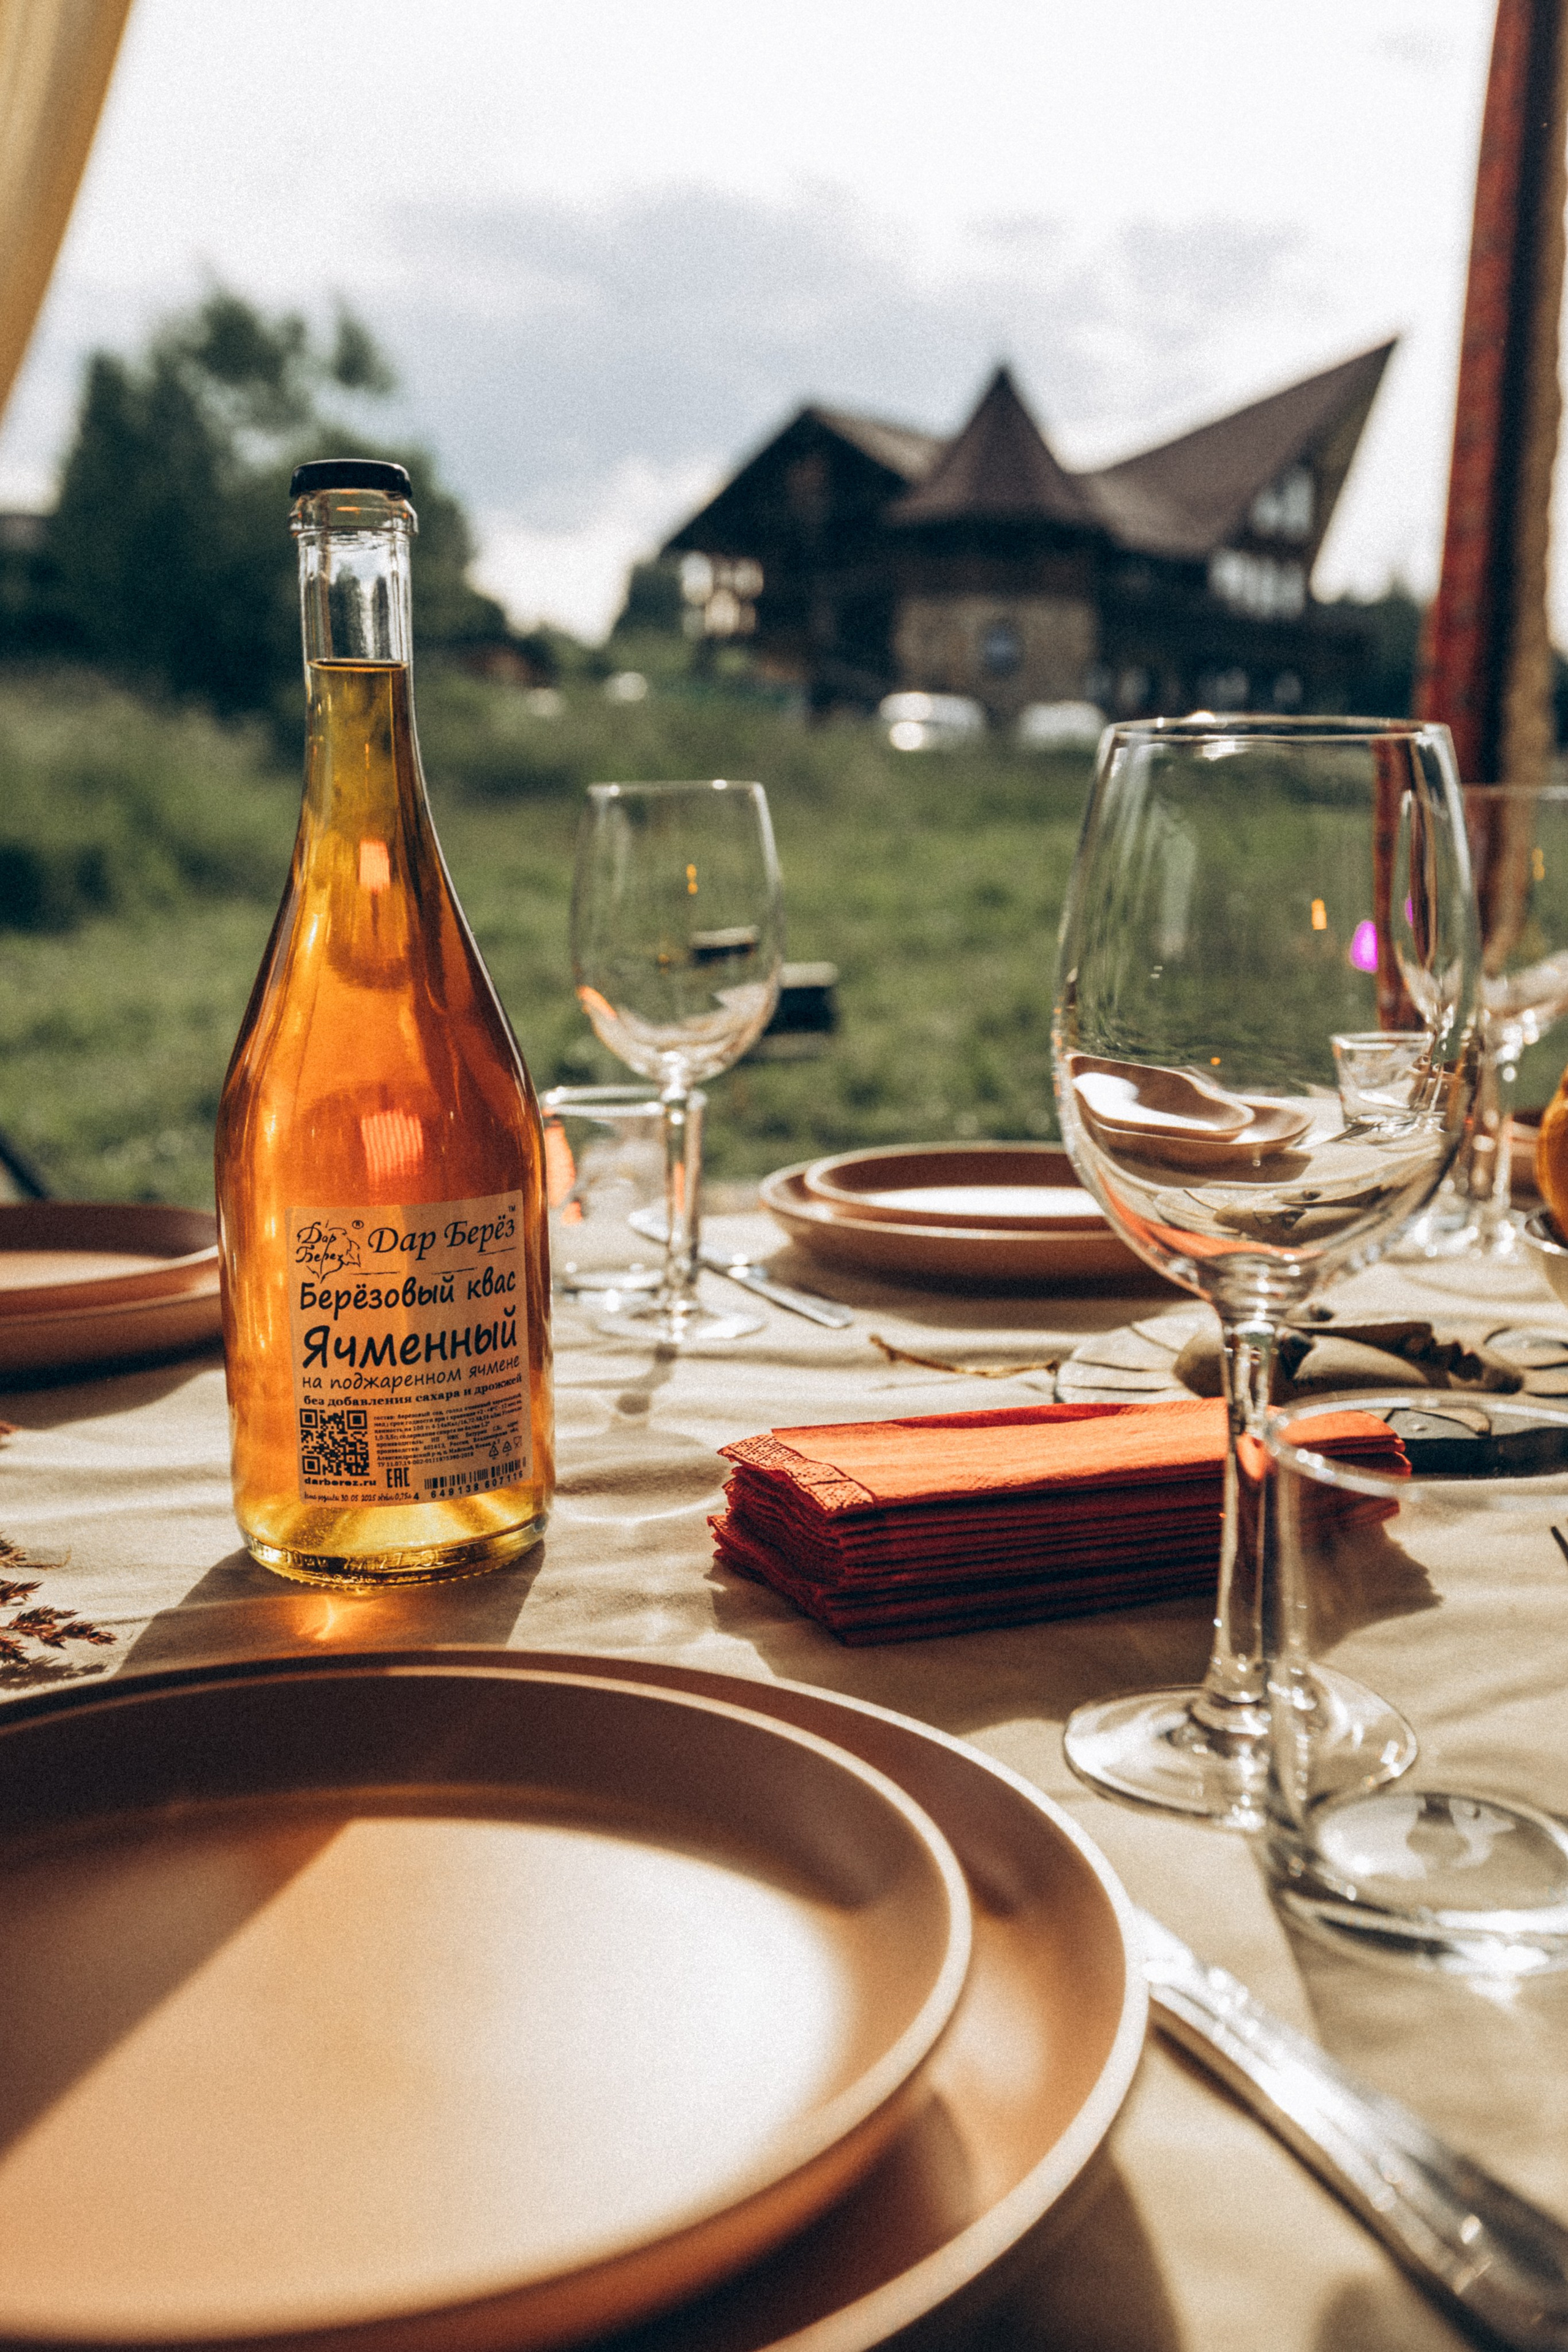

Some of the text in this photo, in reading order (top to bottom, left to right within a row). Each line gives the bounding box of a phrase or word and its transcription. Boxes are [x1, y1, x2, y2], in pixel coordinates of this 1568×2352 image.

[297, 1221, 337, 1244] Дар
[368, 1227, 437, 1261] Дар
[444, 1214, 515, 1253] Берёз
[300, 1266, 516, 1321] Берёзовый квас
[303, 1305, 517, 1369] Ячменный
[303, 1355, 520, 1393] на поджаренном ячмене
[304, 1395, 325, 1406] без
[328, 1396, 412, 1408] добавления
[415, 1390, 461, 1404] сахара
[474, 1373, 522, 1395] дрожжей
